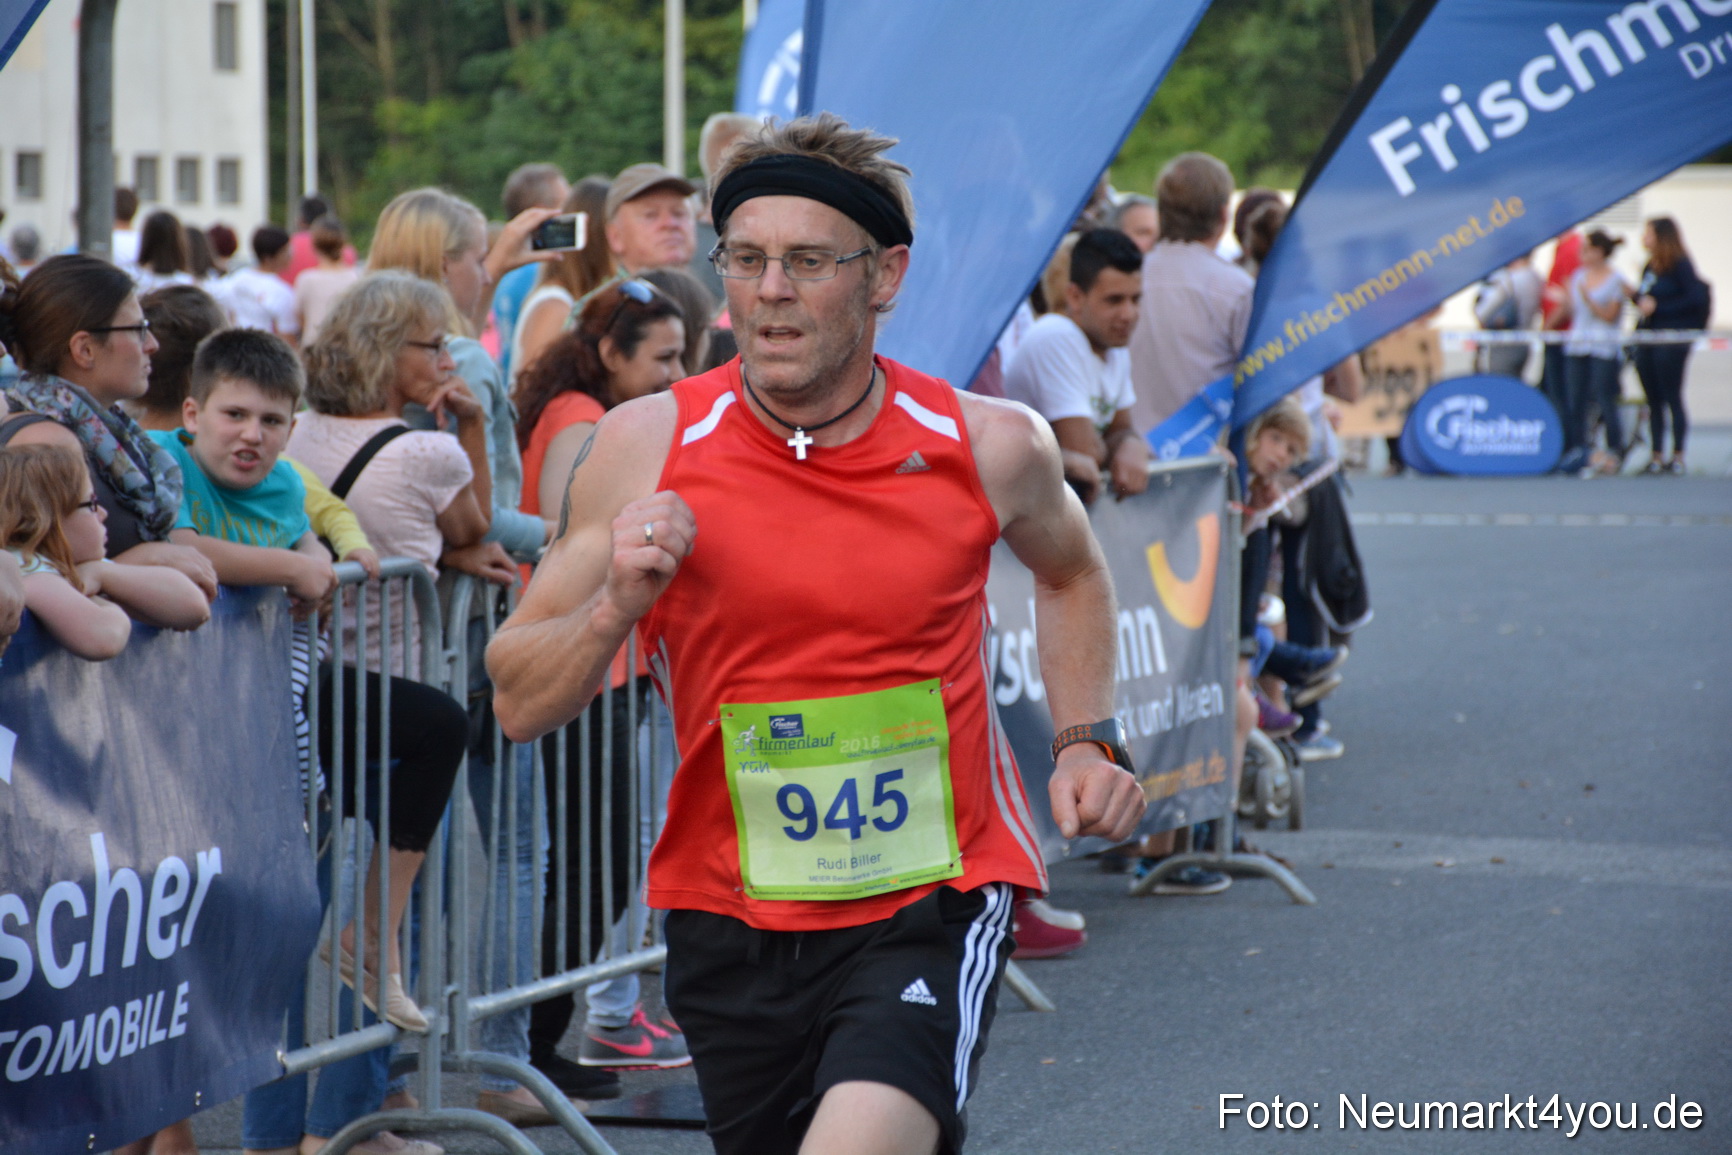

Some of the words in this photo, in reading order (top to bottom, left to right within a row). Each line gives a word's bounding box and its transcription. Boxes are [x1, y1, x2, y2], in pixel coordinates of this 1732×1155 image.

[1440, 402, 1546, 443] Fischer
[758, 732, 836, 751] firmenlauf
[840, 735, 881, 754] 2016
[776, 768, 909, 842] 945
[817, 857, 847, 870] Rudi
[850, 853, 882, 869] Biller
[808, 875, 831, 883] MEIER
[872, 866, 893, 876] GmbH
[900, 993, 938, 1006] adidas
